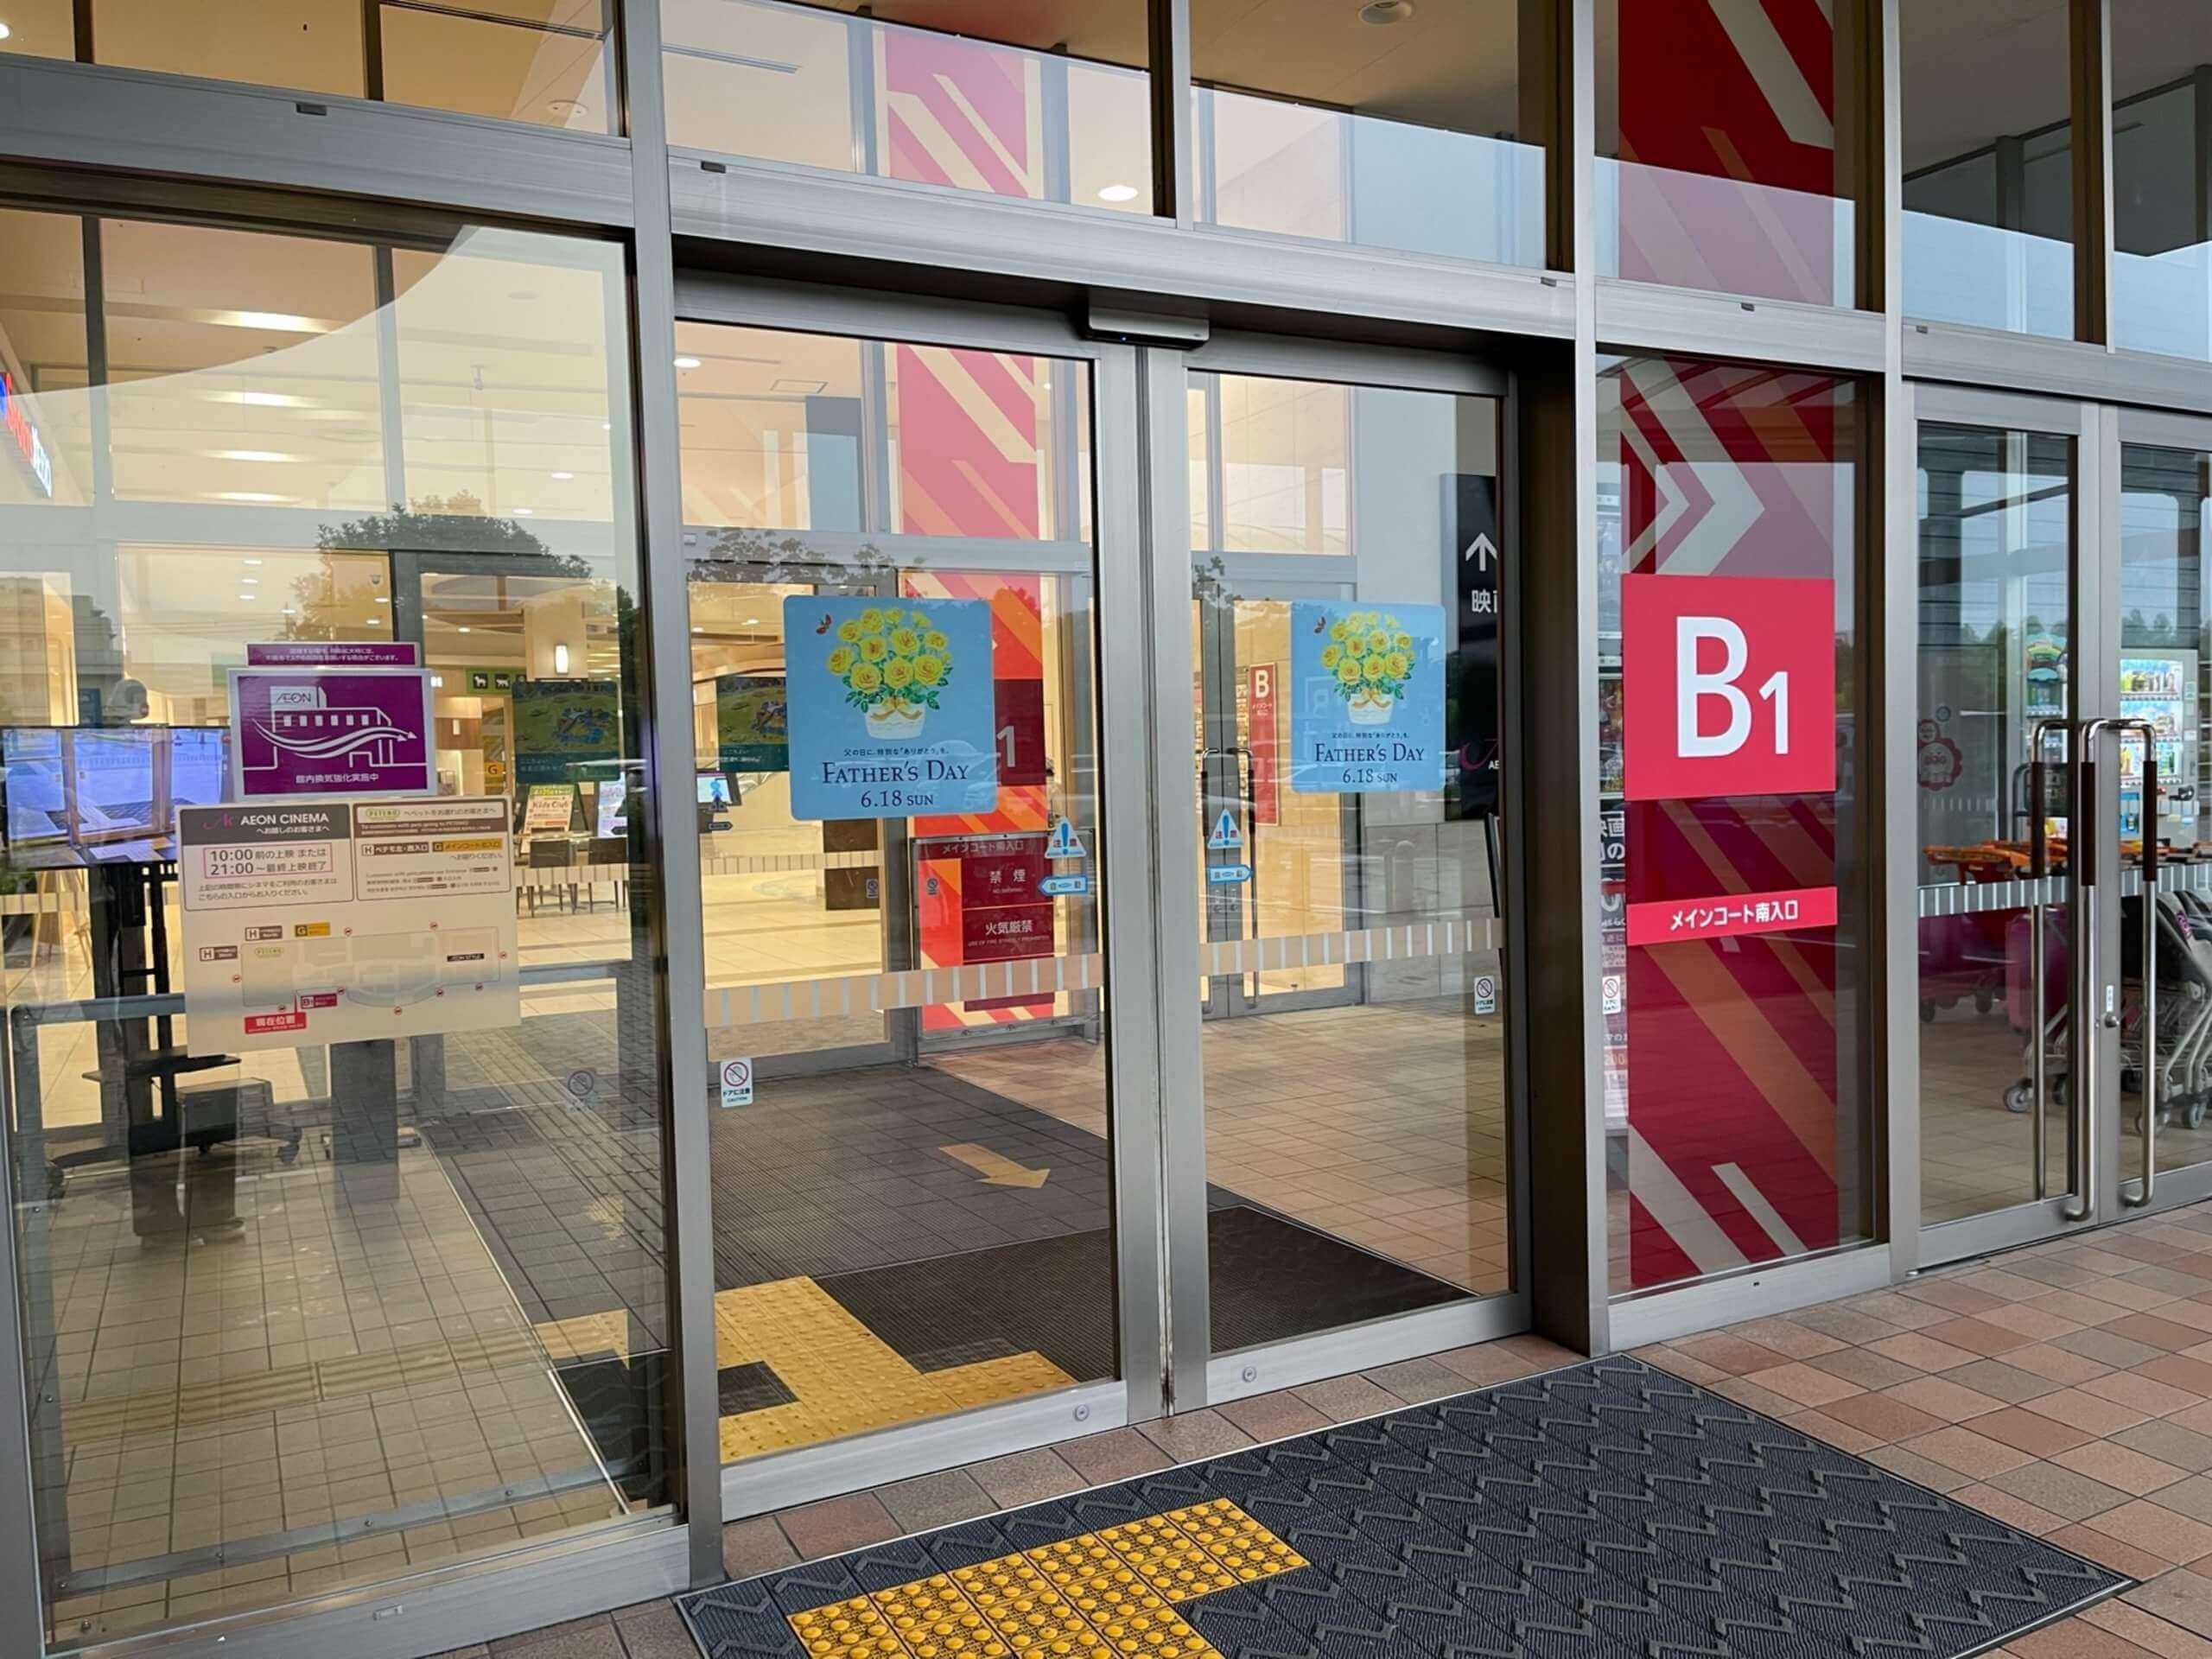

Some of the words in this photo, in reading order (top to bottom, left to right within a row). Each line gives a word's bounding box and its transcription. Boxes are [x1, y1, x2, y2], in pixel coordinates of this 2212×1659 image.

[1471, 589, 1498, 613] 映
[1255, 670, 1269, 698] B
[1676, 615, 1789, 758] B1
[996, 725, 1015, 767] 1
[1314, 742, 1387, 762] FATHER'S
[1393, 742, 1425, 761] DAY
[488, 765, 498, 774] G
[822, 760, 918, 785] FATHER'S
[926, 760, 969, 780] DAY
[1343, 768, 1373, 784] 6.18
[1377, 773, 1397, 783] SUN
[861, 790, 902, 807] 6.18
[907, 794, 934, 806] SUN
[240, 815, 276, 826] AEON
[279, 812, 330, 824] CINEMA
[209, 849, 253, 862] 10:00
[210, 862, 254, 876] 21:00
[1669, 899, 1799, 931] メインコート南入口
[249, 929, 257, 938] H
[297, 925, 307, 936] G
[985, 918, 1033, 935] 火気厳禁
[203, 949, 212, 958] H
[255, 1014, 296, 1027] 現在位置
